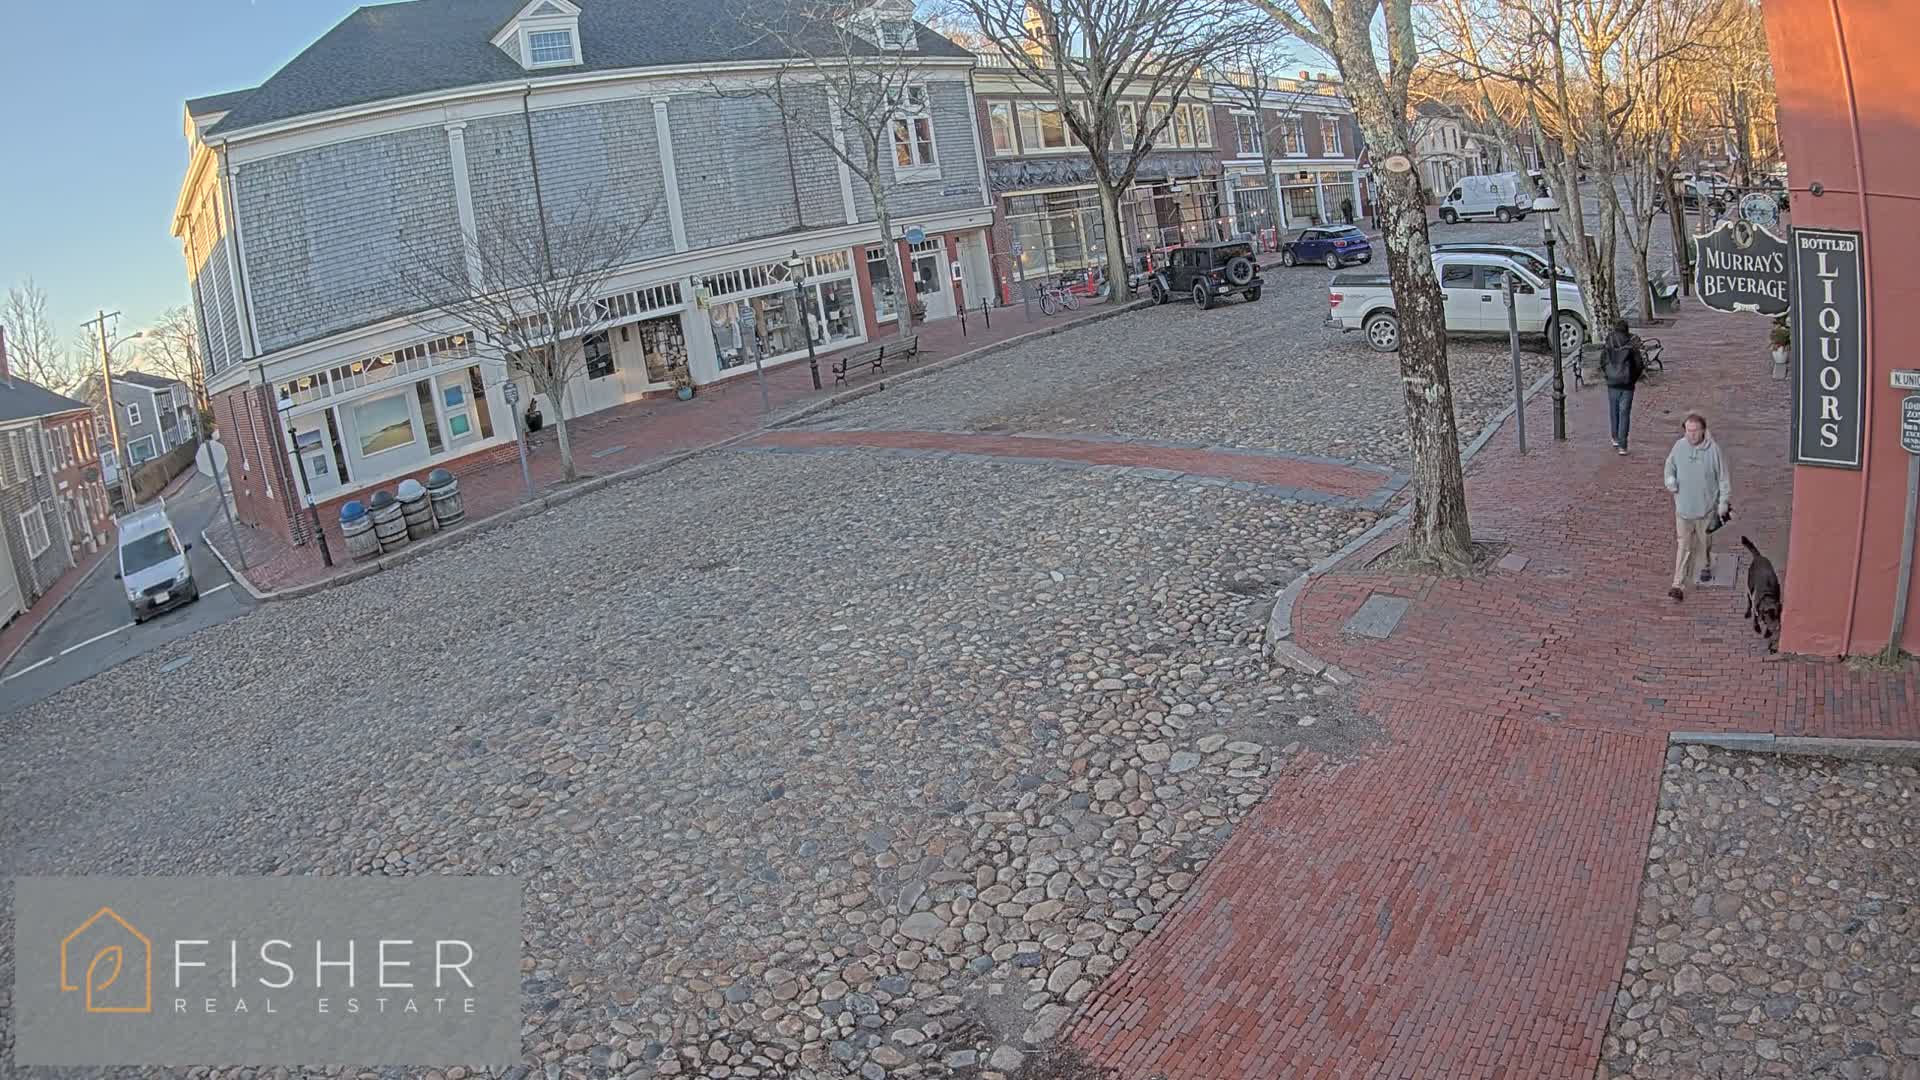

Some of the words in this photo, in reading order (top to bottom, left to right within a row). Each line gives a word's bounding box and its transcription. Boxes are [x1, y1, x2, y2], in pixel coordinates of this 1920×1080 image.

[1801, 237, 1855, 252] BOTTLED
[1706, 246, 1784, 273] MURRAY'S
[1705, 275, 1788, 302] BEVERAGE
[1817, 252, 1843, 448] LIQUORS
